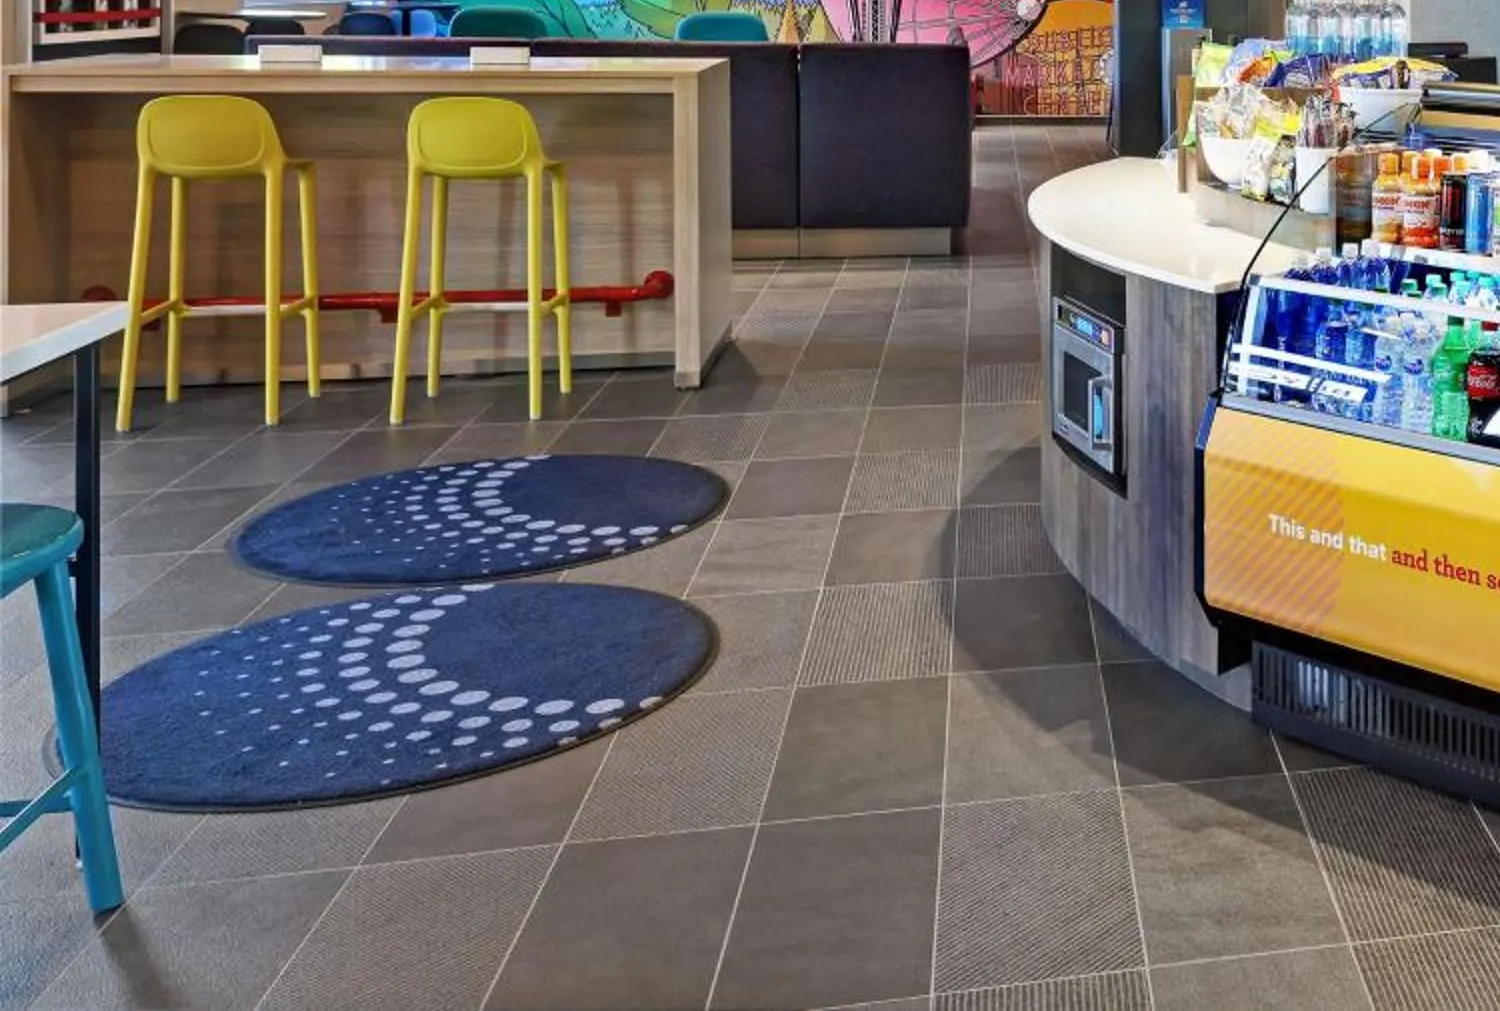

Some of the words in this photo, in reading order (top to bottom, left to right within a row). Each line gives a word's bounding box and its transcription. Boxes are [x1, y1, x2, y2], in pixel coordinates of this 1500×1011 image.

[1268, 513, 1305, 540] This
[1310, 527, 1343, 550] and
[1350, 535, 1387, 561] that
[1391, 548, 1428, 573] and
[1434, 554, 1481, 586] then
